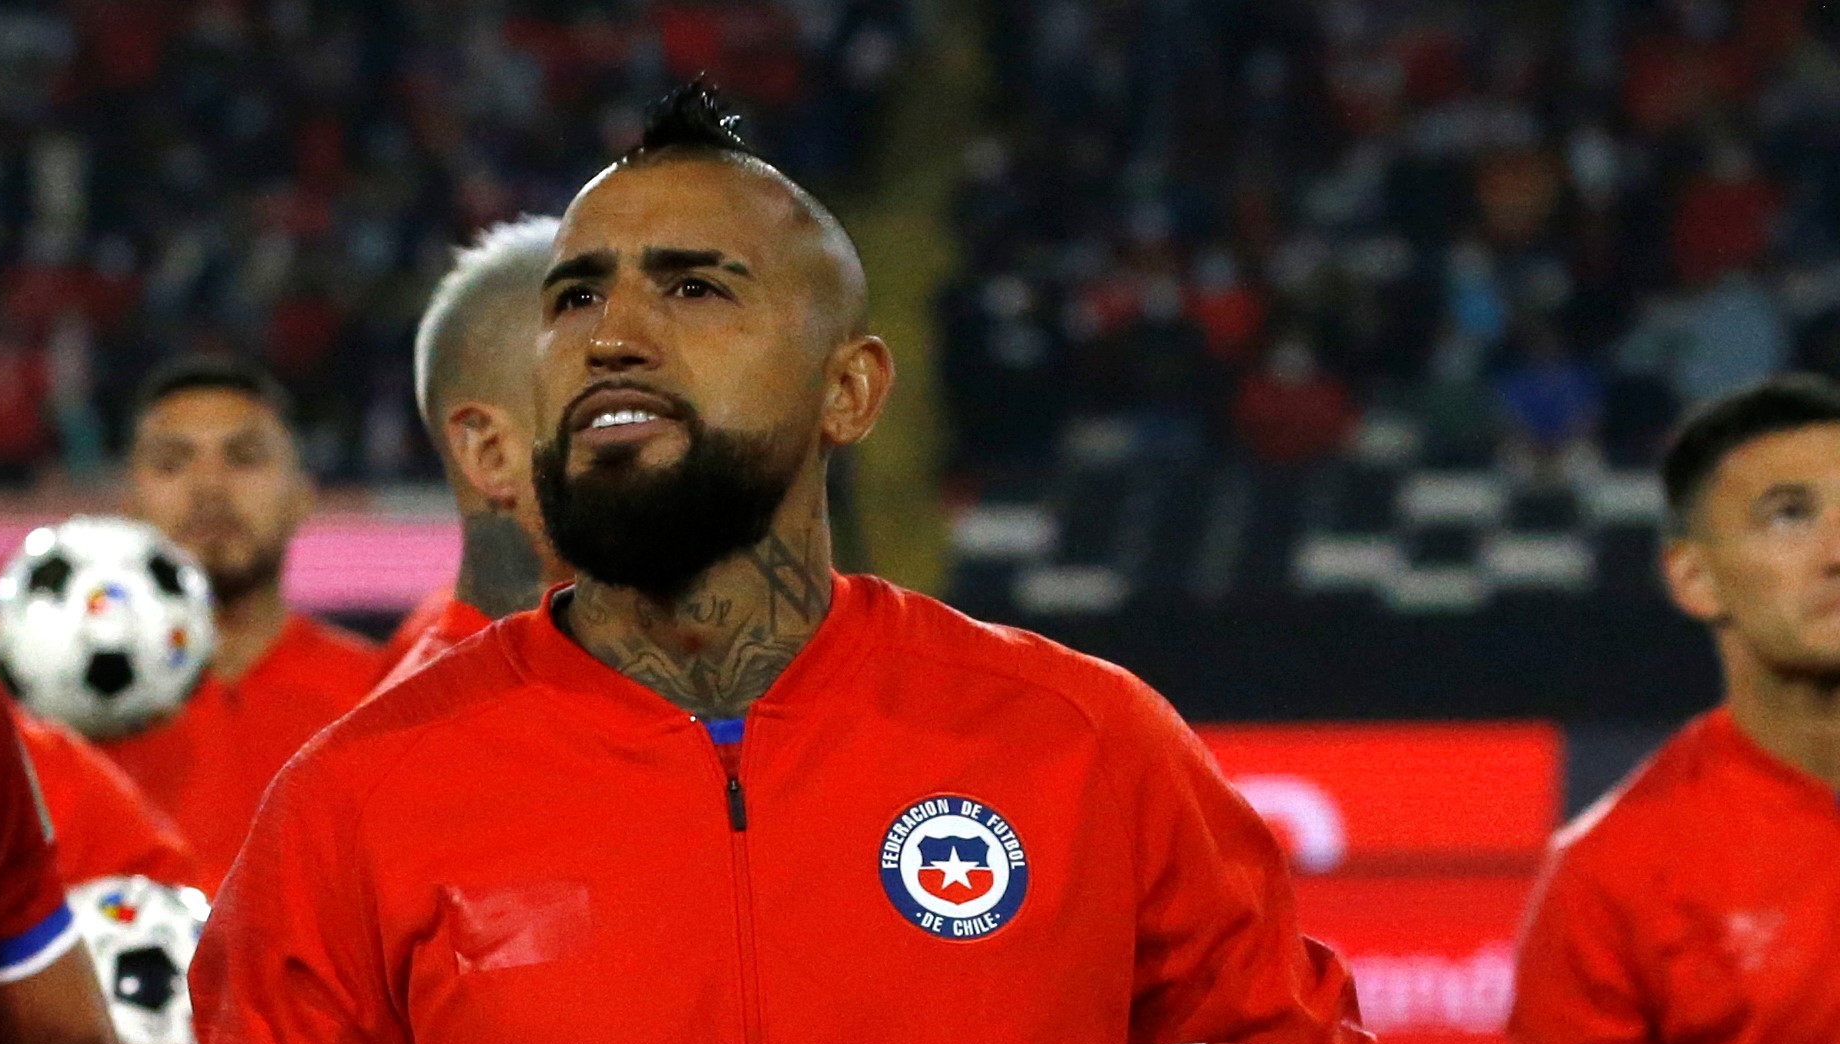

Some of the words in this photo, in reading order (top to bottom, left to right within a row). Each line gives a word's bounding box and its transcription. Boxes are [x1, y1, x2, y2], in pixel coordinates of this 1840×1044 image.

[882, 799, 950, 869] FEDERACION
[961, 799, 983, 820] DE
[987, 814, 1026, 869] FUTBOL
[921, 912, 943, 932] DE
[953, 912, 997, 936] CHILE
